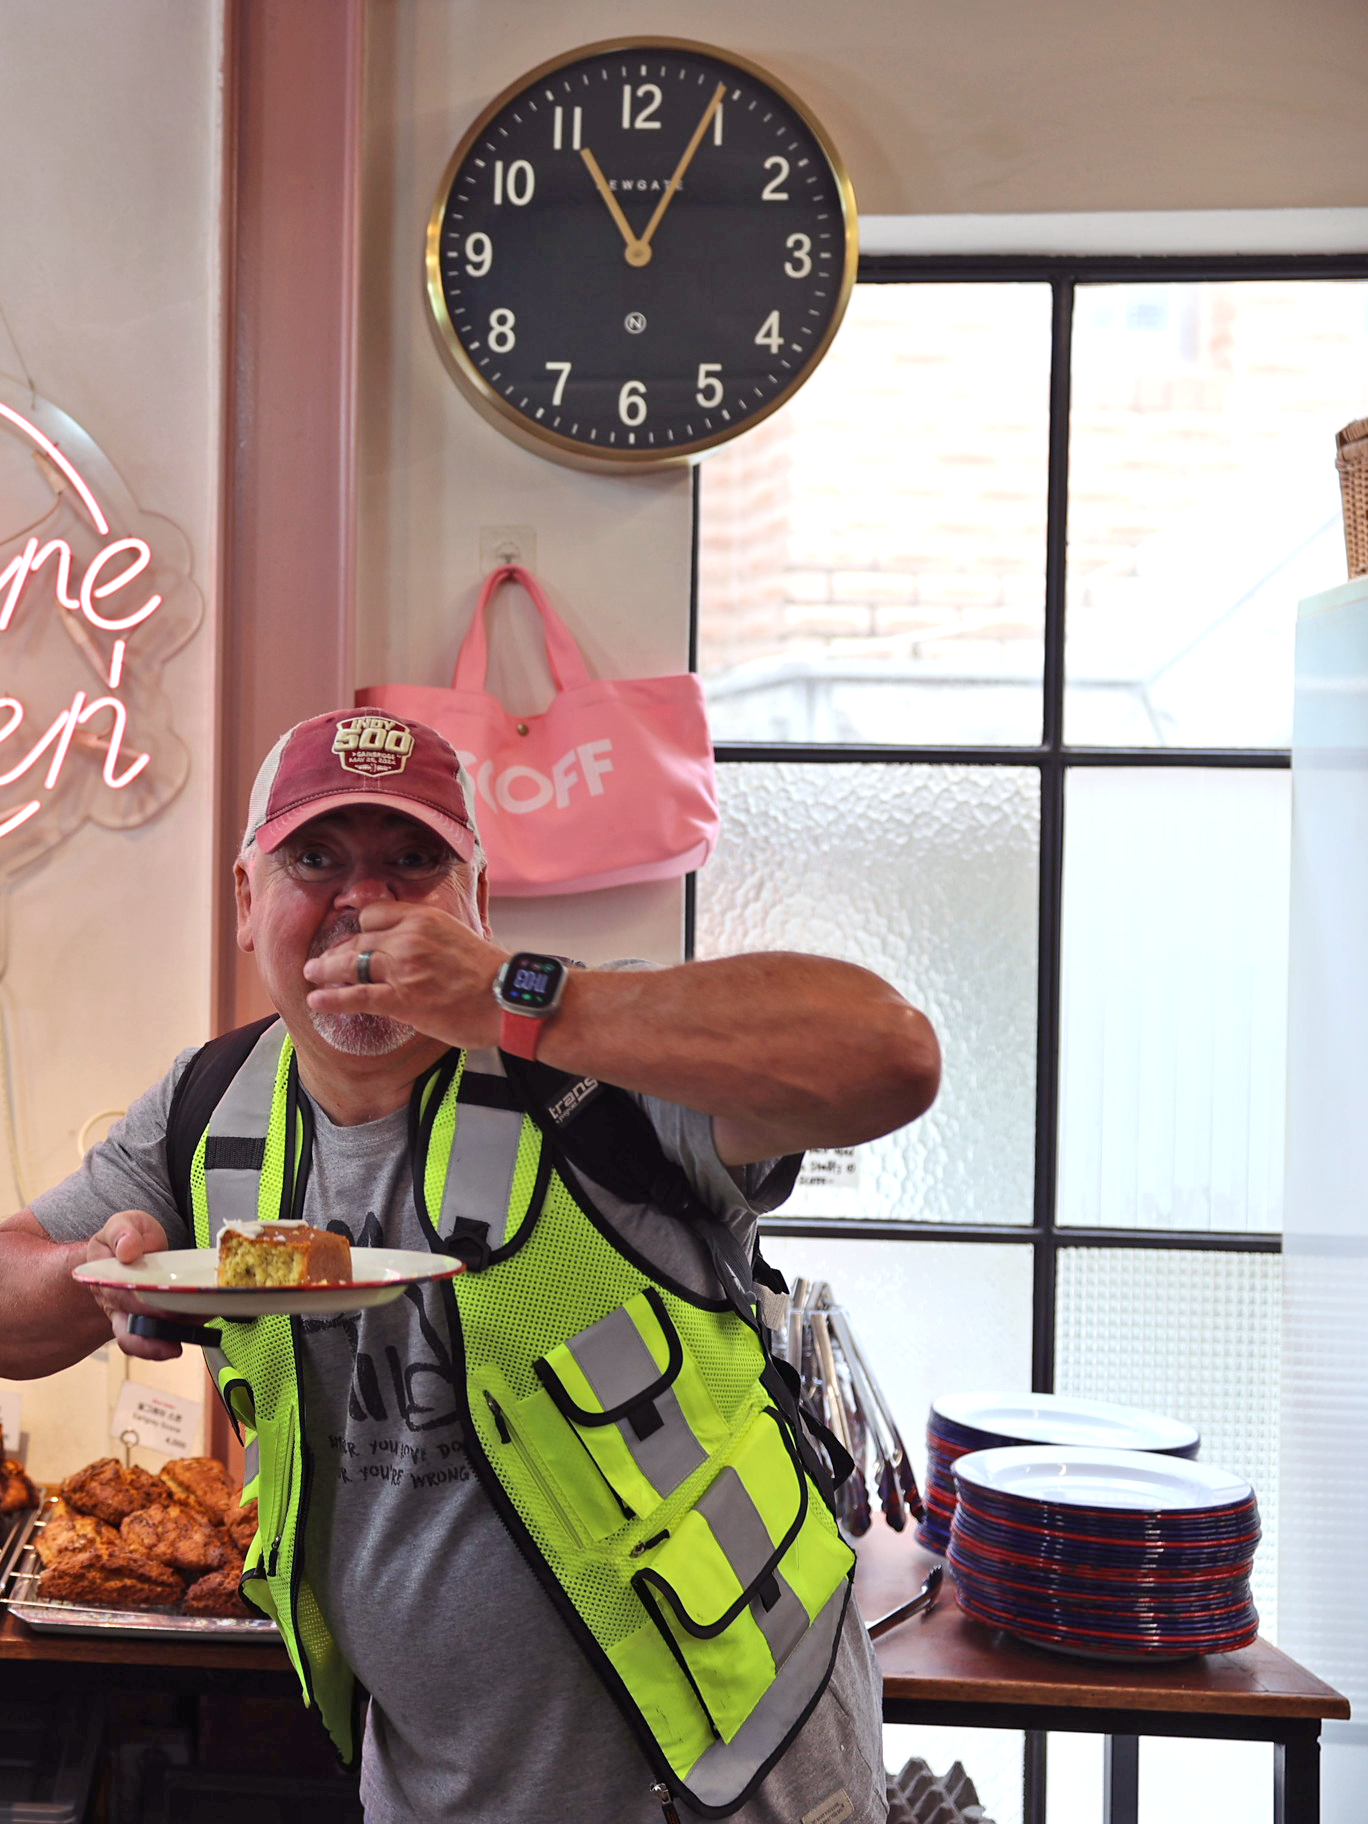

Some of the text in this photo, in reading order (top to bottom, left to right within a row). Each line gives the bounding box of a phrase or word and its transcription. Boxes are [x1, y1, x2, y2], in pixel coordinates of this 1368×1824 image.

[553, 106, 582, 150] 11
[621, 83, 662, 129] 12
[713, 102, 723, 146] 1
[494, 160, 535, 206] 10
[597, 179, 684, 191] EWGAE
[761, 155, 790, 200] 2
[464, 232, 493, 277] 9
[784, 232, 812, 278] 3
[487, 308, 516, 353] 8
[754, 310, 784, 354] 4
[545, 362, 572, 406] 7
[618, 380, 648, 427] 6
[696, 363, 724, 408] 5
[334, 728, 412, 755] 500
[350, 718, 396, 730] INDY
[370, 1439, 398, 1455] YOU
[437, 1440, 463, 1459] DO
[360, 1463, 405, 1486] YOU'RE
